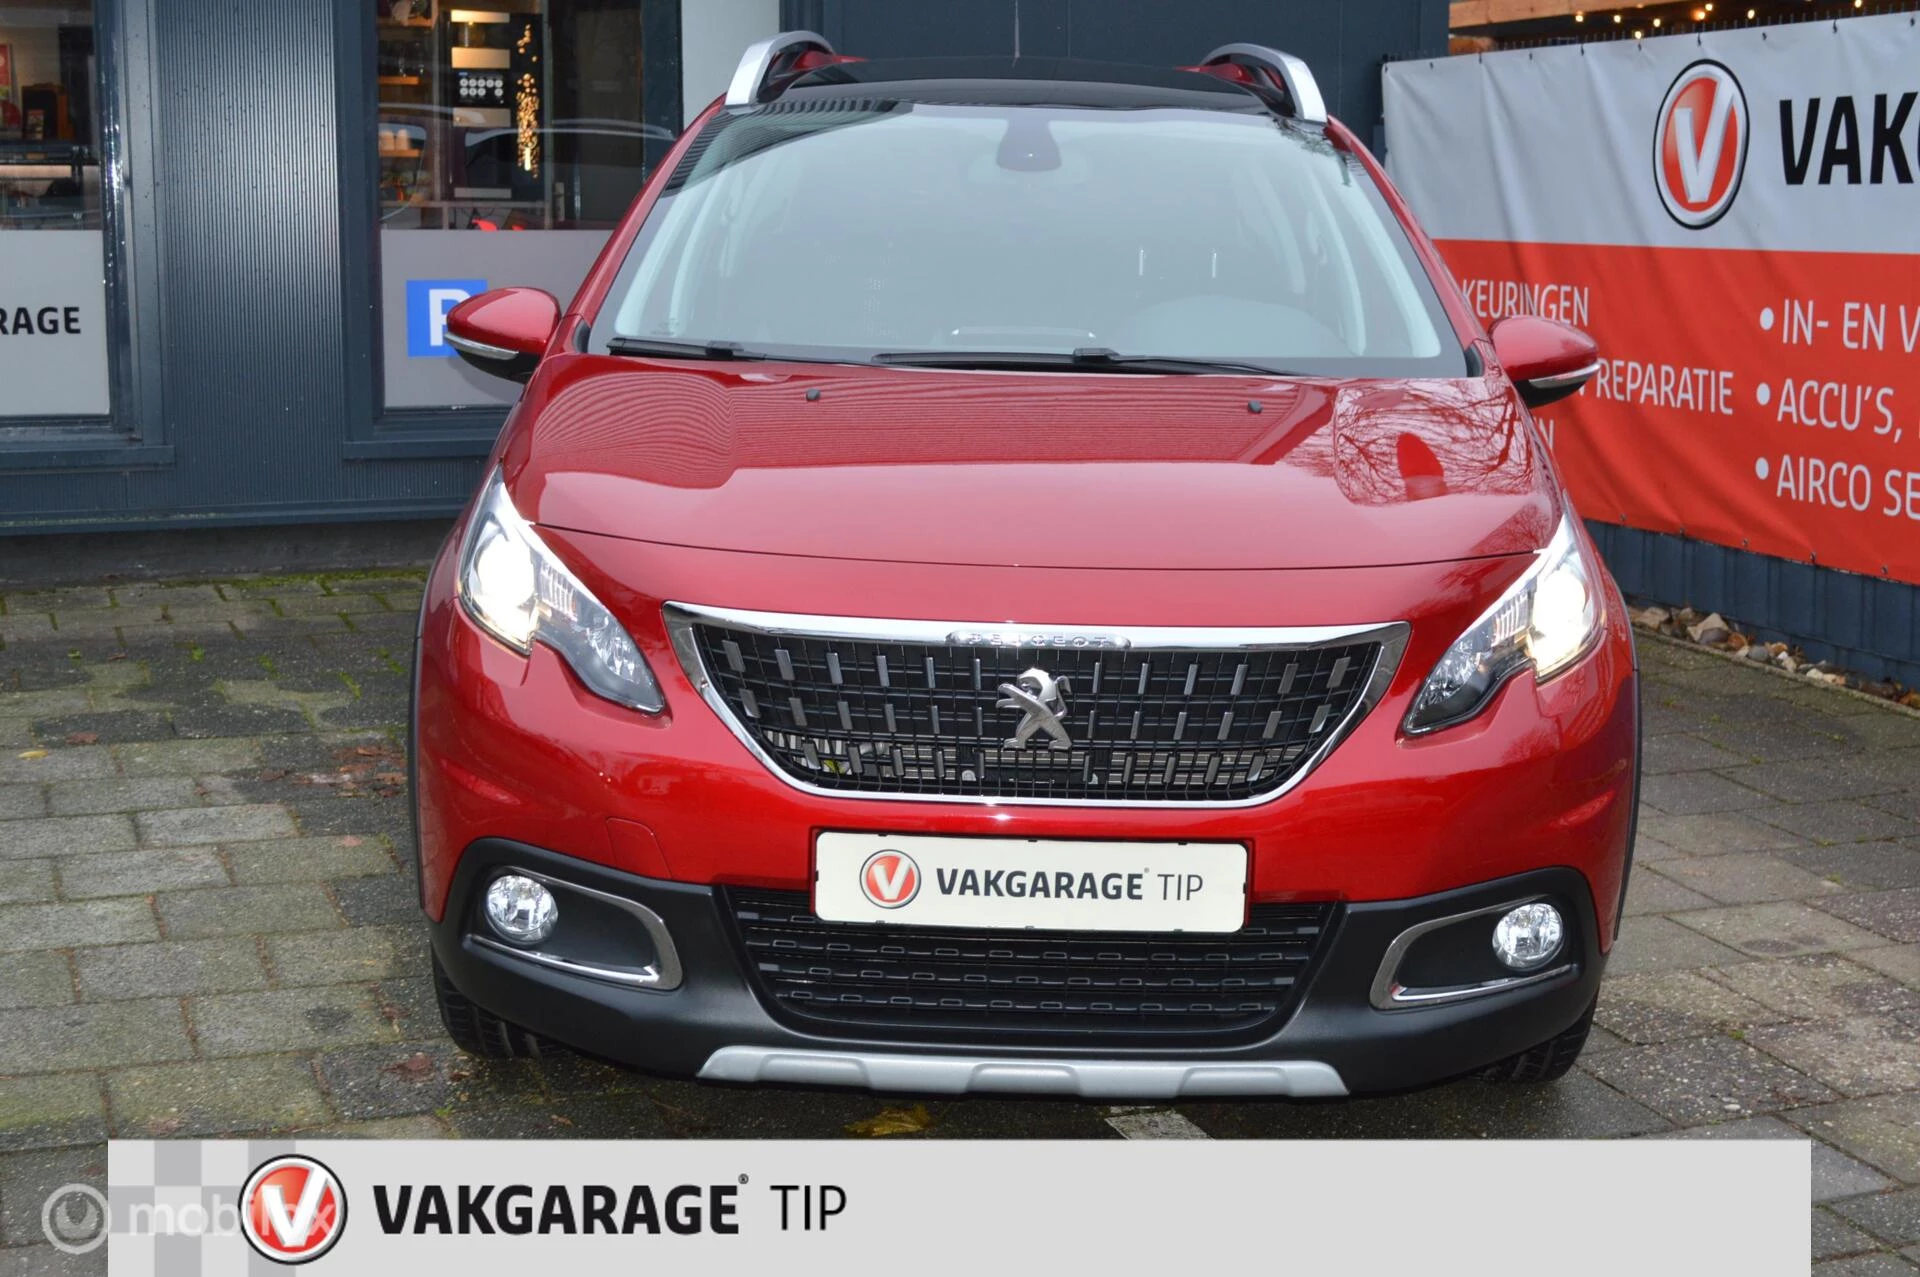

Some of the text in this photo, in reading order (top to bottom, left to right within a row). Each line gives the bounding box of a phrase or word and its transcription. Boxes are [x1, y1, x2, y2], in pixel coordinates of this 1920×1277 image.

[1780, 91, 1920, 186] VAK
[1462, 278, 1590, 327] KEURINGEN
[1782, 298, 1830, 346] IN-
[1842, 302, 1886, 352] EN
[1596, 357, 1734, 415] REPARATIE
[1776, 454, 1920, 521] AIRCO SE
[935, 867, 1144, 901] VAKGARAGE
[1157, 873, 1204, 901] TIP
